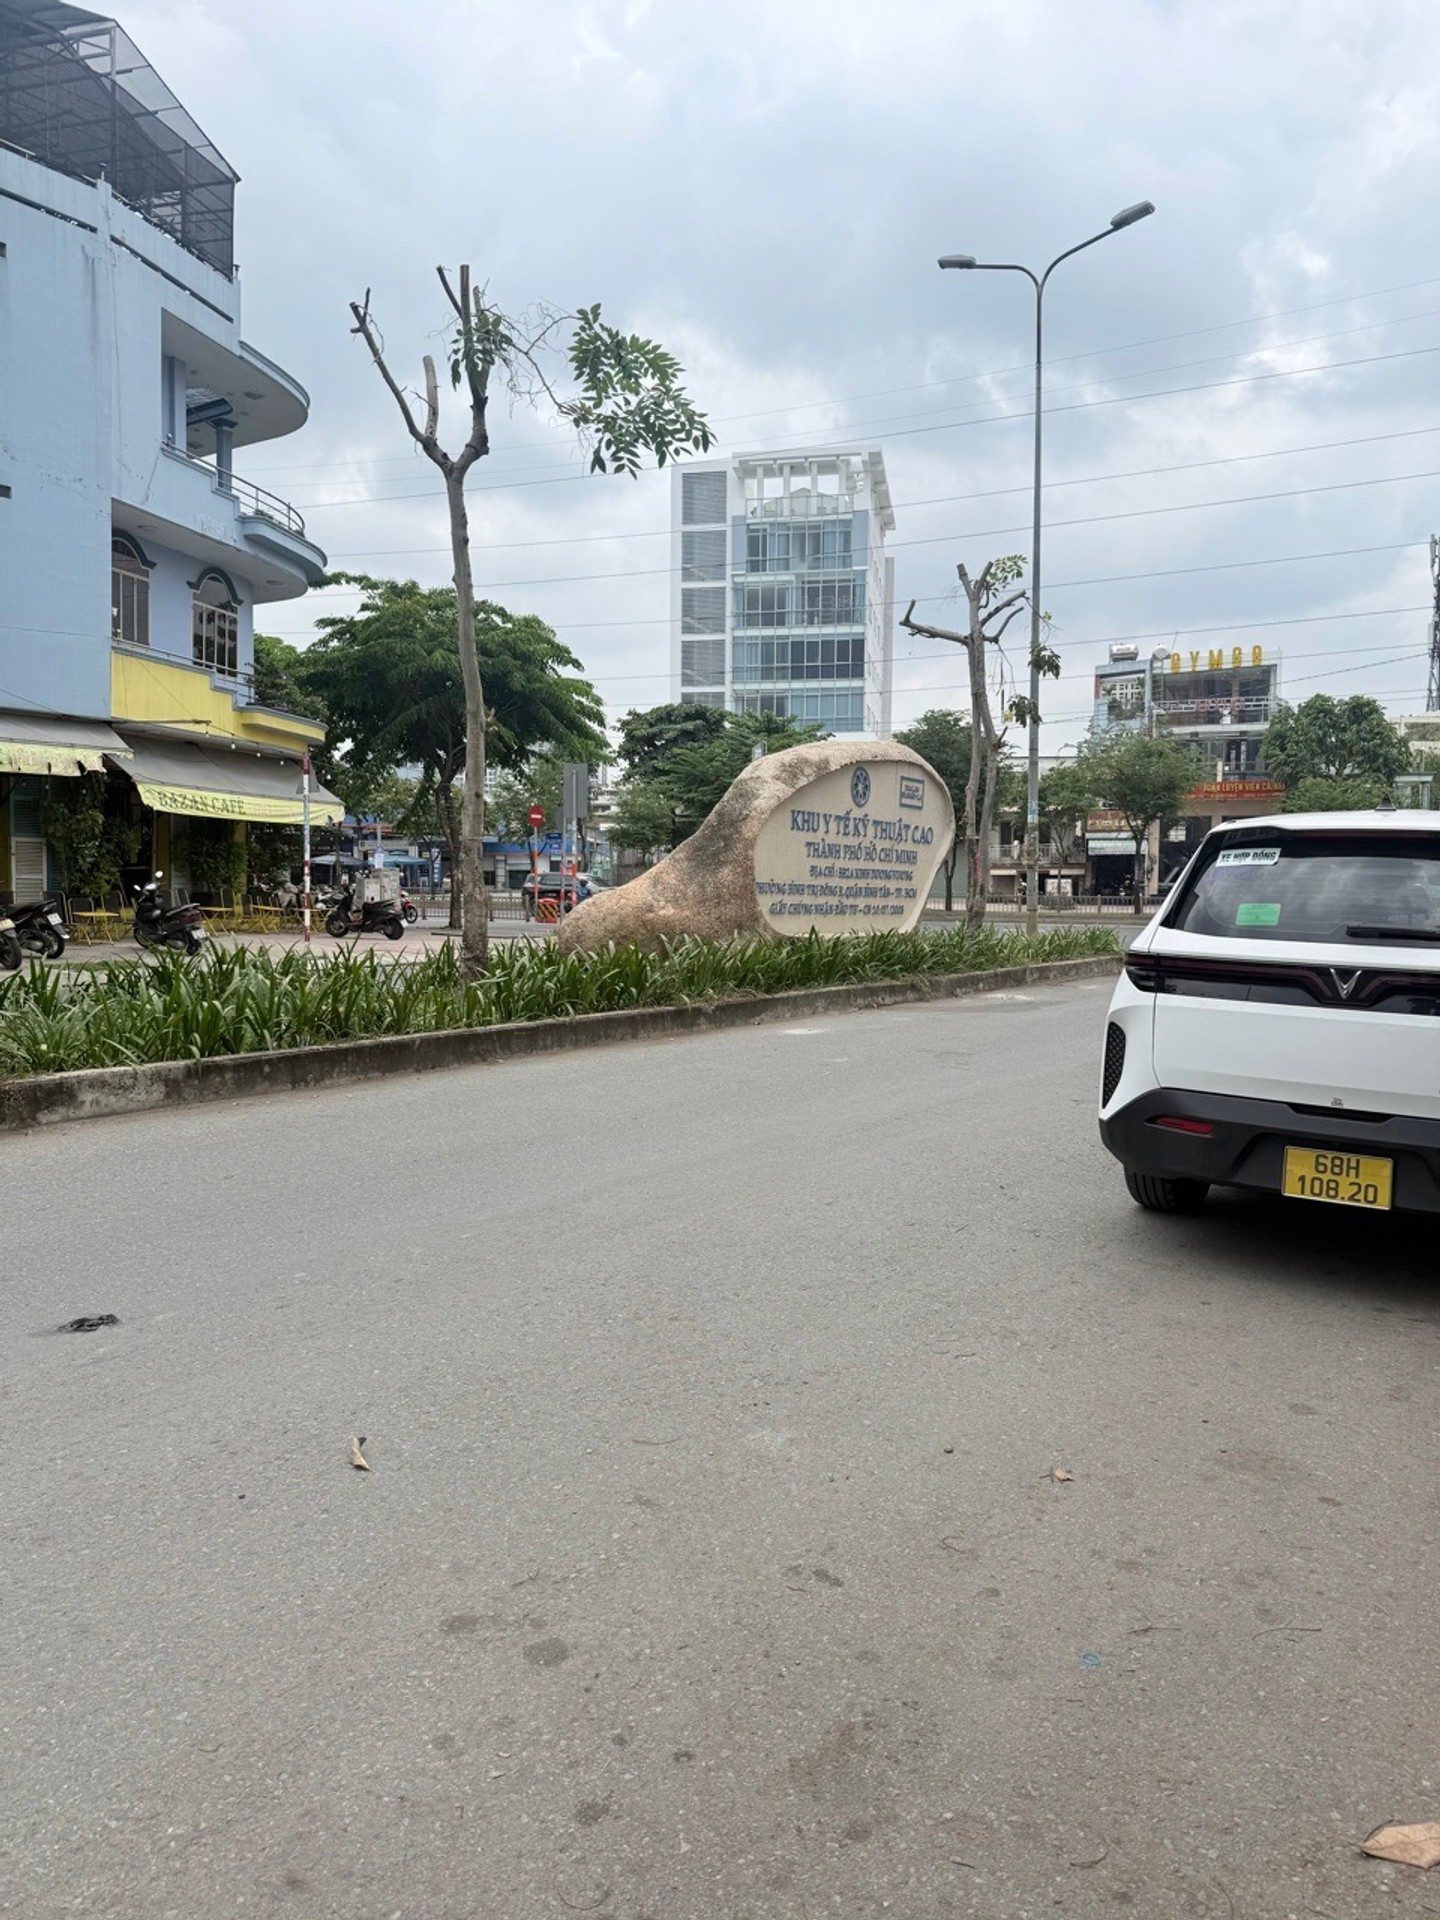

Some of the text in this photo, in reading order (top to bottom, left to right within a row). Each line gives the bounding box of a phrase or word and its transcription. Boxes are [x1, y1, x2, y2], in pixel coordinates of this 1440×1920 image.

[790, 809, 820, 832] KHU
[823, 813, 832, 834] Y
[834, 808, 852, 836] TẾ
[872, 818, 911, 844] THUẬT
[912, 825, 934, 845] CAO
[805, 838, 918, 865] THÀNH PHỐ HỒ CHÍ MINH
[1220, 854, 1232, 863] XE
[1314, 1153, 1360, 1179] 68H
[1297, 1174, 1378, 1205] 108.20
